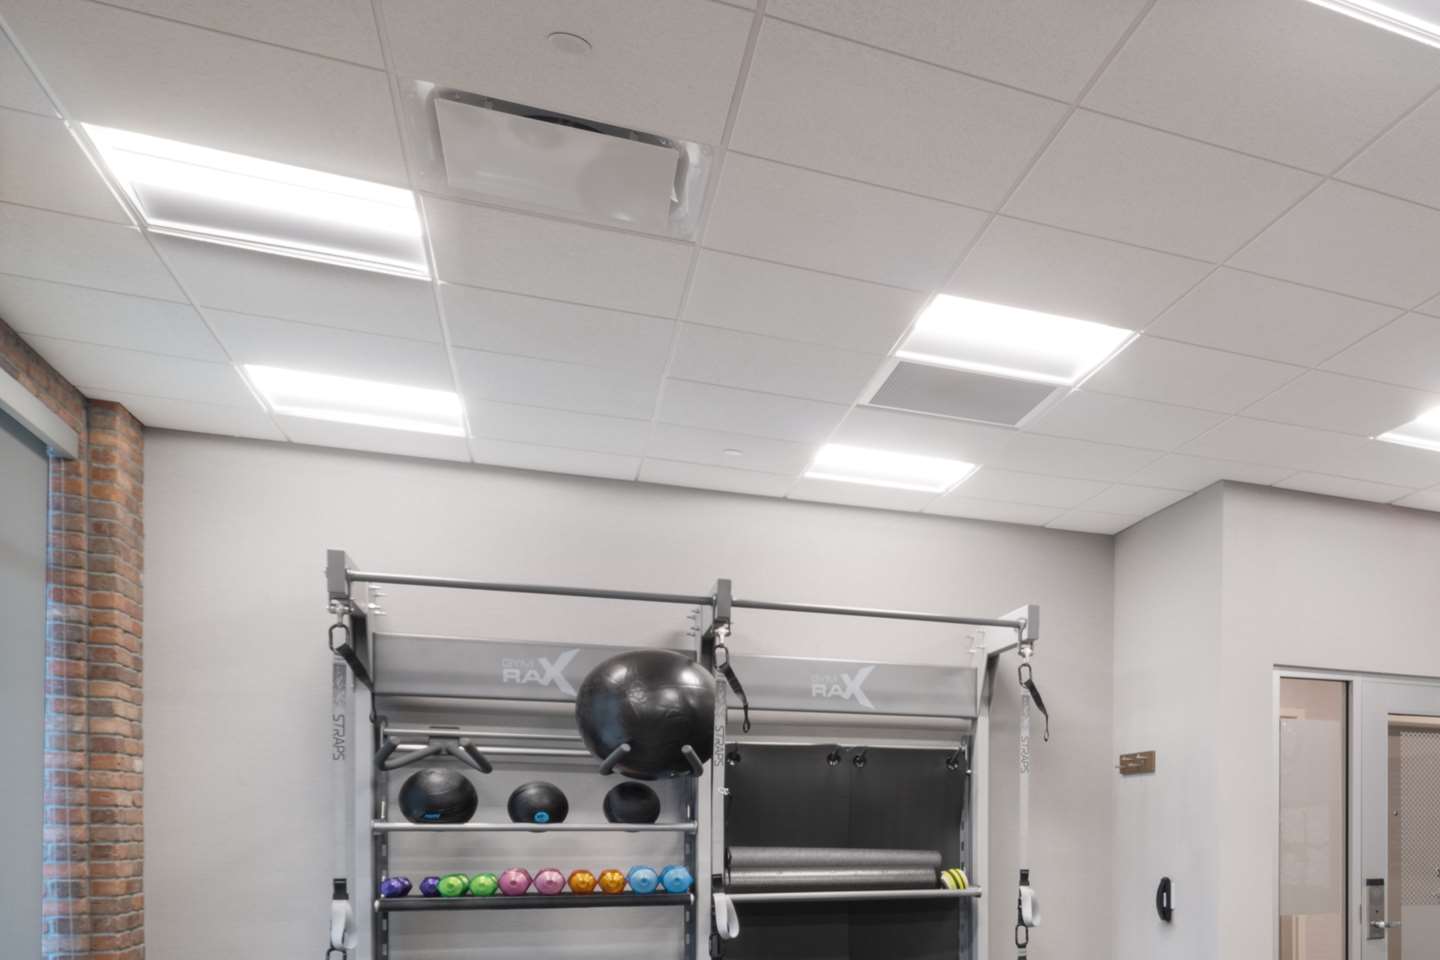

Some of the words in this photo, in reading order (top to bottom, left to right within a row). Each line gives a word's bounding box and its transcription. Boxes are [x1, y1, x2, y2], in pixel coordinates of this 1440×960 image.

[502, 648, 580, 697] RAX
[811, 664, 877, 709] RAX
[332, 714, 345, 761] STRAPS
[714, 725, 725, 767] STRAPS
